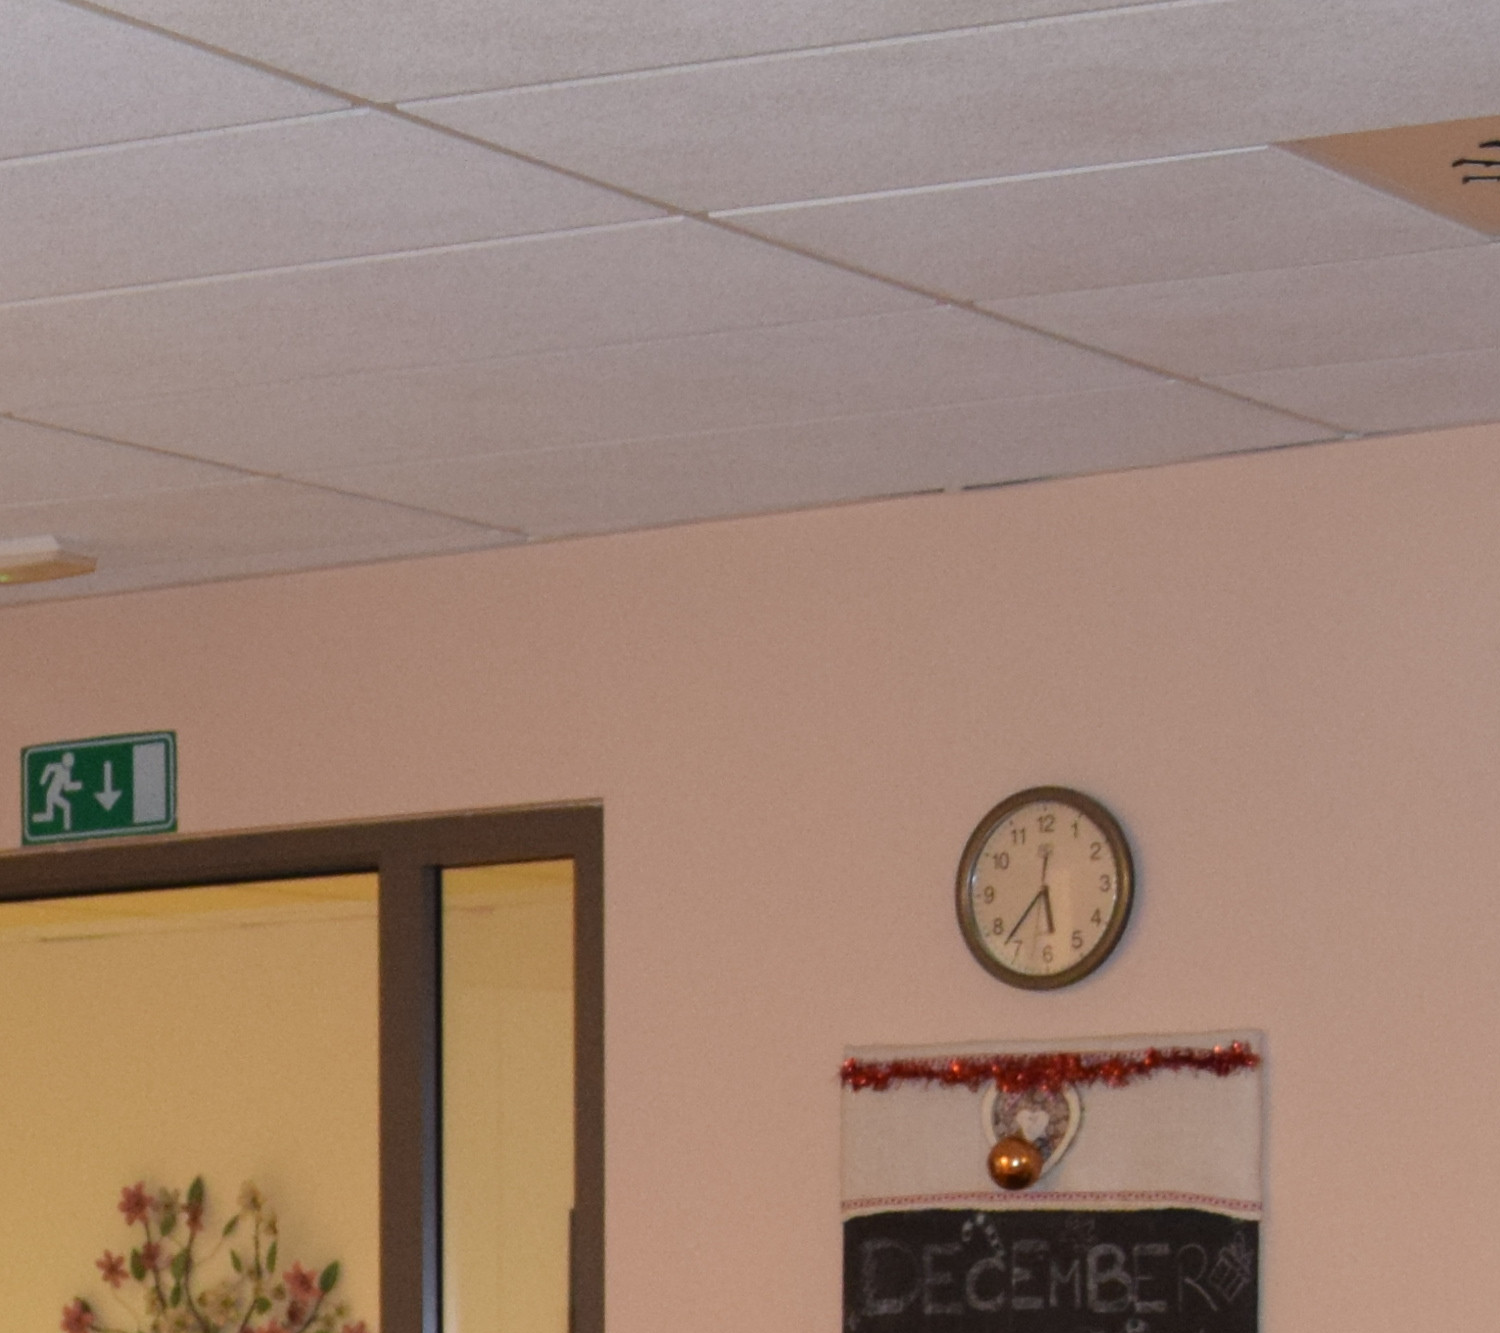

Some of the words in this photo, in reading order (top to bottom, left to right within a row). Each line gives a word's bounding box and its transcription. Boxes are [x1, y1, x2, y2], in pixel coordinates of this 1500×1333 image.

[1037, 814, 1056, 833] 12
[1071, 822, 1079, 838] 1
[1011, 827, 1027, 845] 11
[993, 851, 1009, 870] 10
[1089, 842, 1103, 861] 2
[1099, 874, 1111, 892] 3
[983, 885, 995, 903] 9
[993, 918, 1005, 935] 8
[1090, 909, 1102, 927] 4
[1012, 940, 1022, 957] 7
[1071, 931, 1083, 949] 5
[1042, 947, 1053, 963] 6
[862, 1237, 1218, 1315] DECEMBER
